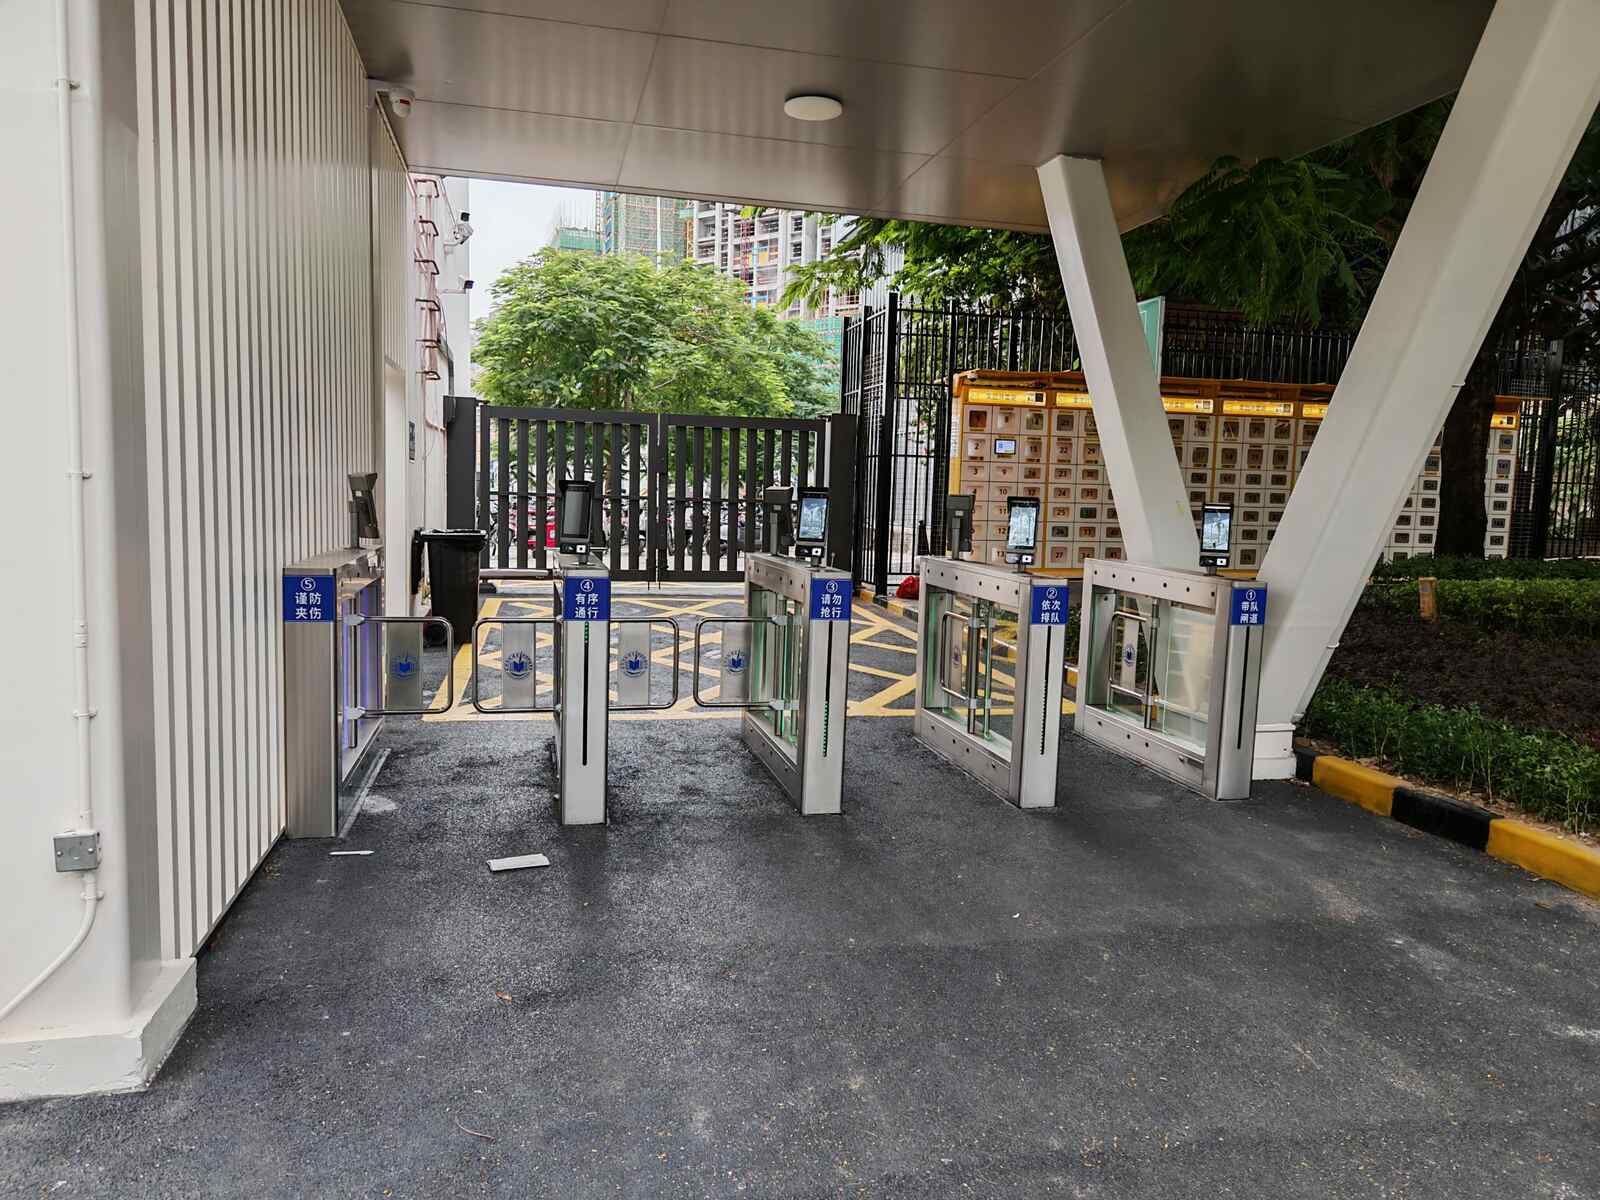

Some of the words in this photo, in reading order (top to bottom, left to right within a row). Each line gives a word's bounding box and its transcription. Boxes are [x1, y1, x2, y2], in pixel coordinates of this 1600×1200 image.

[295, 591, 322, 605] 谨防
[575, 592, 599, 605] 有序
[820, 593, 842, 606] 请勿
[1041, 599, 1061, 611] 依次
[1240, 600, 1259, 612] 带队
[295, 606, 322, 620] 夹伤
[574, 606, 599, 619] 通行
[820, 606, 842, 618] 抢行
[1040, 612, 1060, 623] 排队
[1240, 613, 1259, 624] 闸道
